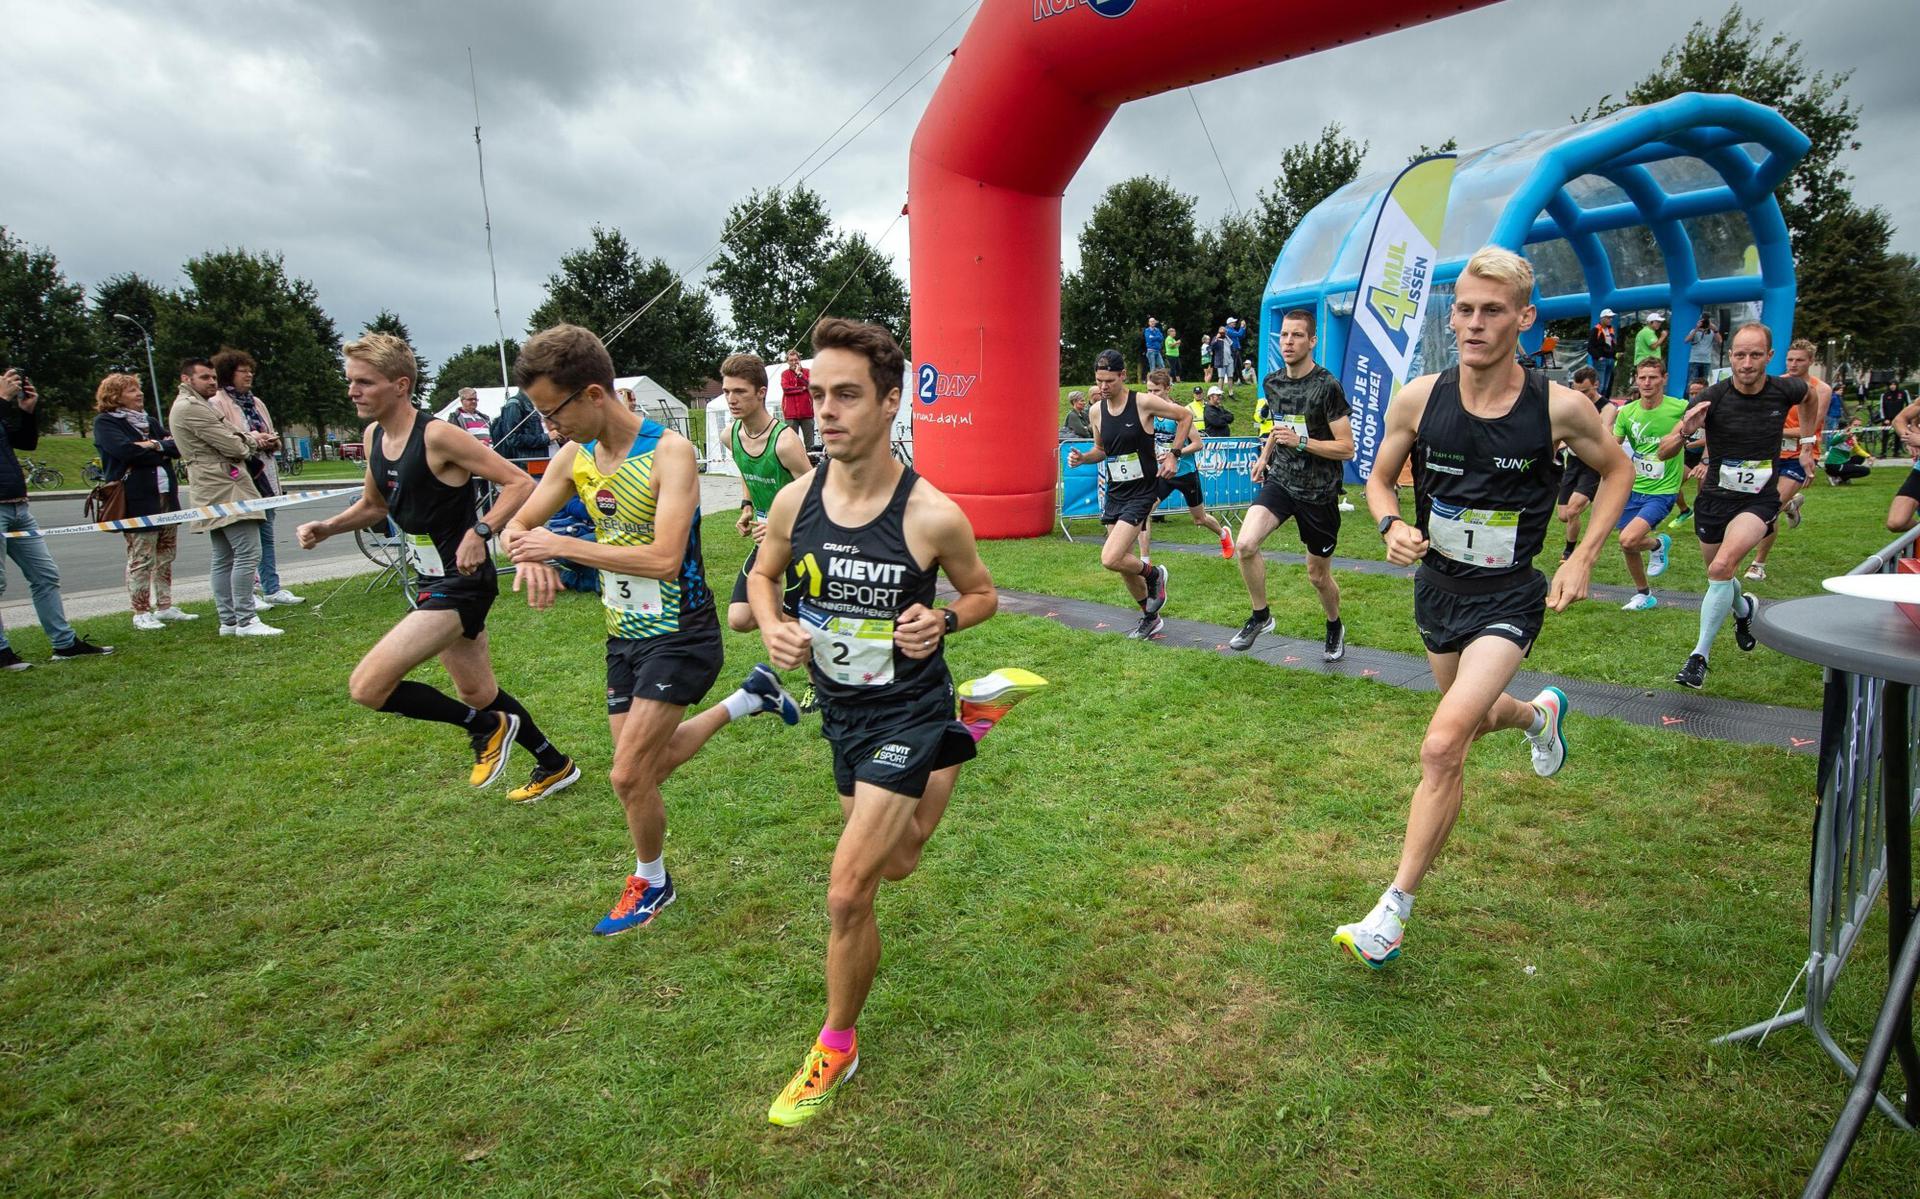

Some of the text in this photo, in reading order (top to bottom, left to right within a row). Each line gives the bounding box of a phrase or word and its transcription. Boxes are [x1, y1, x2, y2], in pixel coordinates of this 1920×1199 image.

[1401, 265, 1413, 290] VAN
[1357, 354, 1370, 374] IN
[1354, 374, 1368, 396] JE
[1359, 371, 1382, 480] EN LOOP MEE!
[1121, 464, 1127, 474] 6
[1641, 462, 1653, 472] 10
[1737, 472, 1755, 484] 12
[1464, 529, 1474, 549] 1
[828, 556, 907, 584] KIEVIT
[617, 580, 632, 599] 3
[828, 581, 903, 607] SPORT
[831, 641, 851, 666] 2
[880, 751, 908, 764] SPORT
